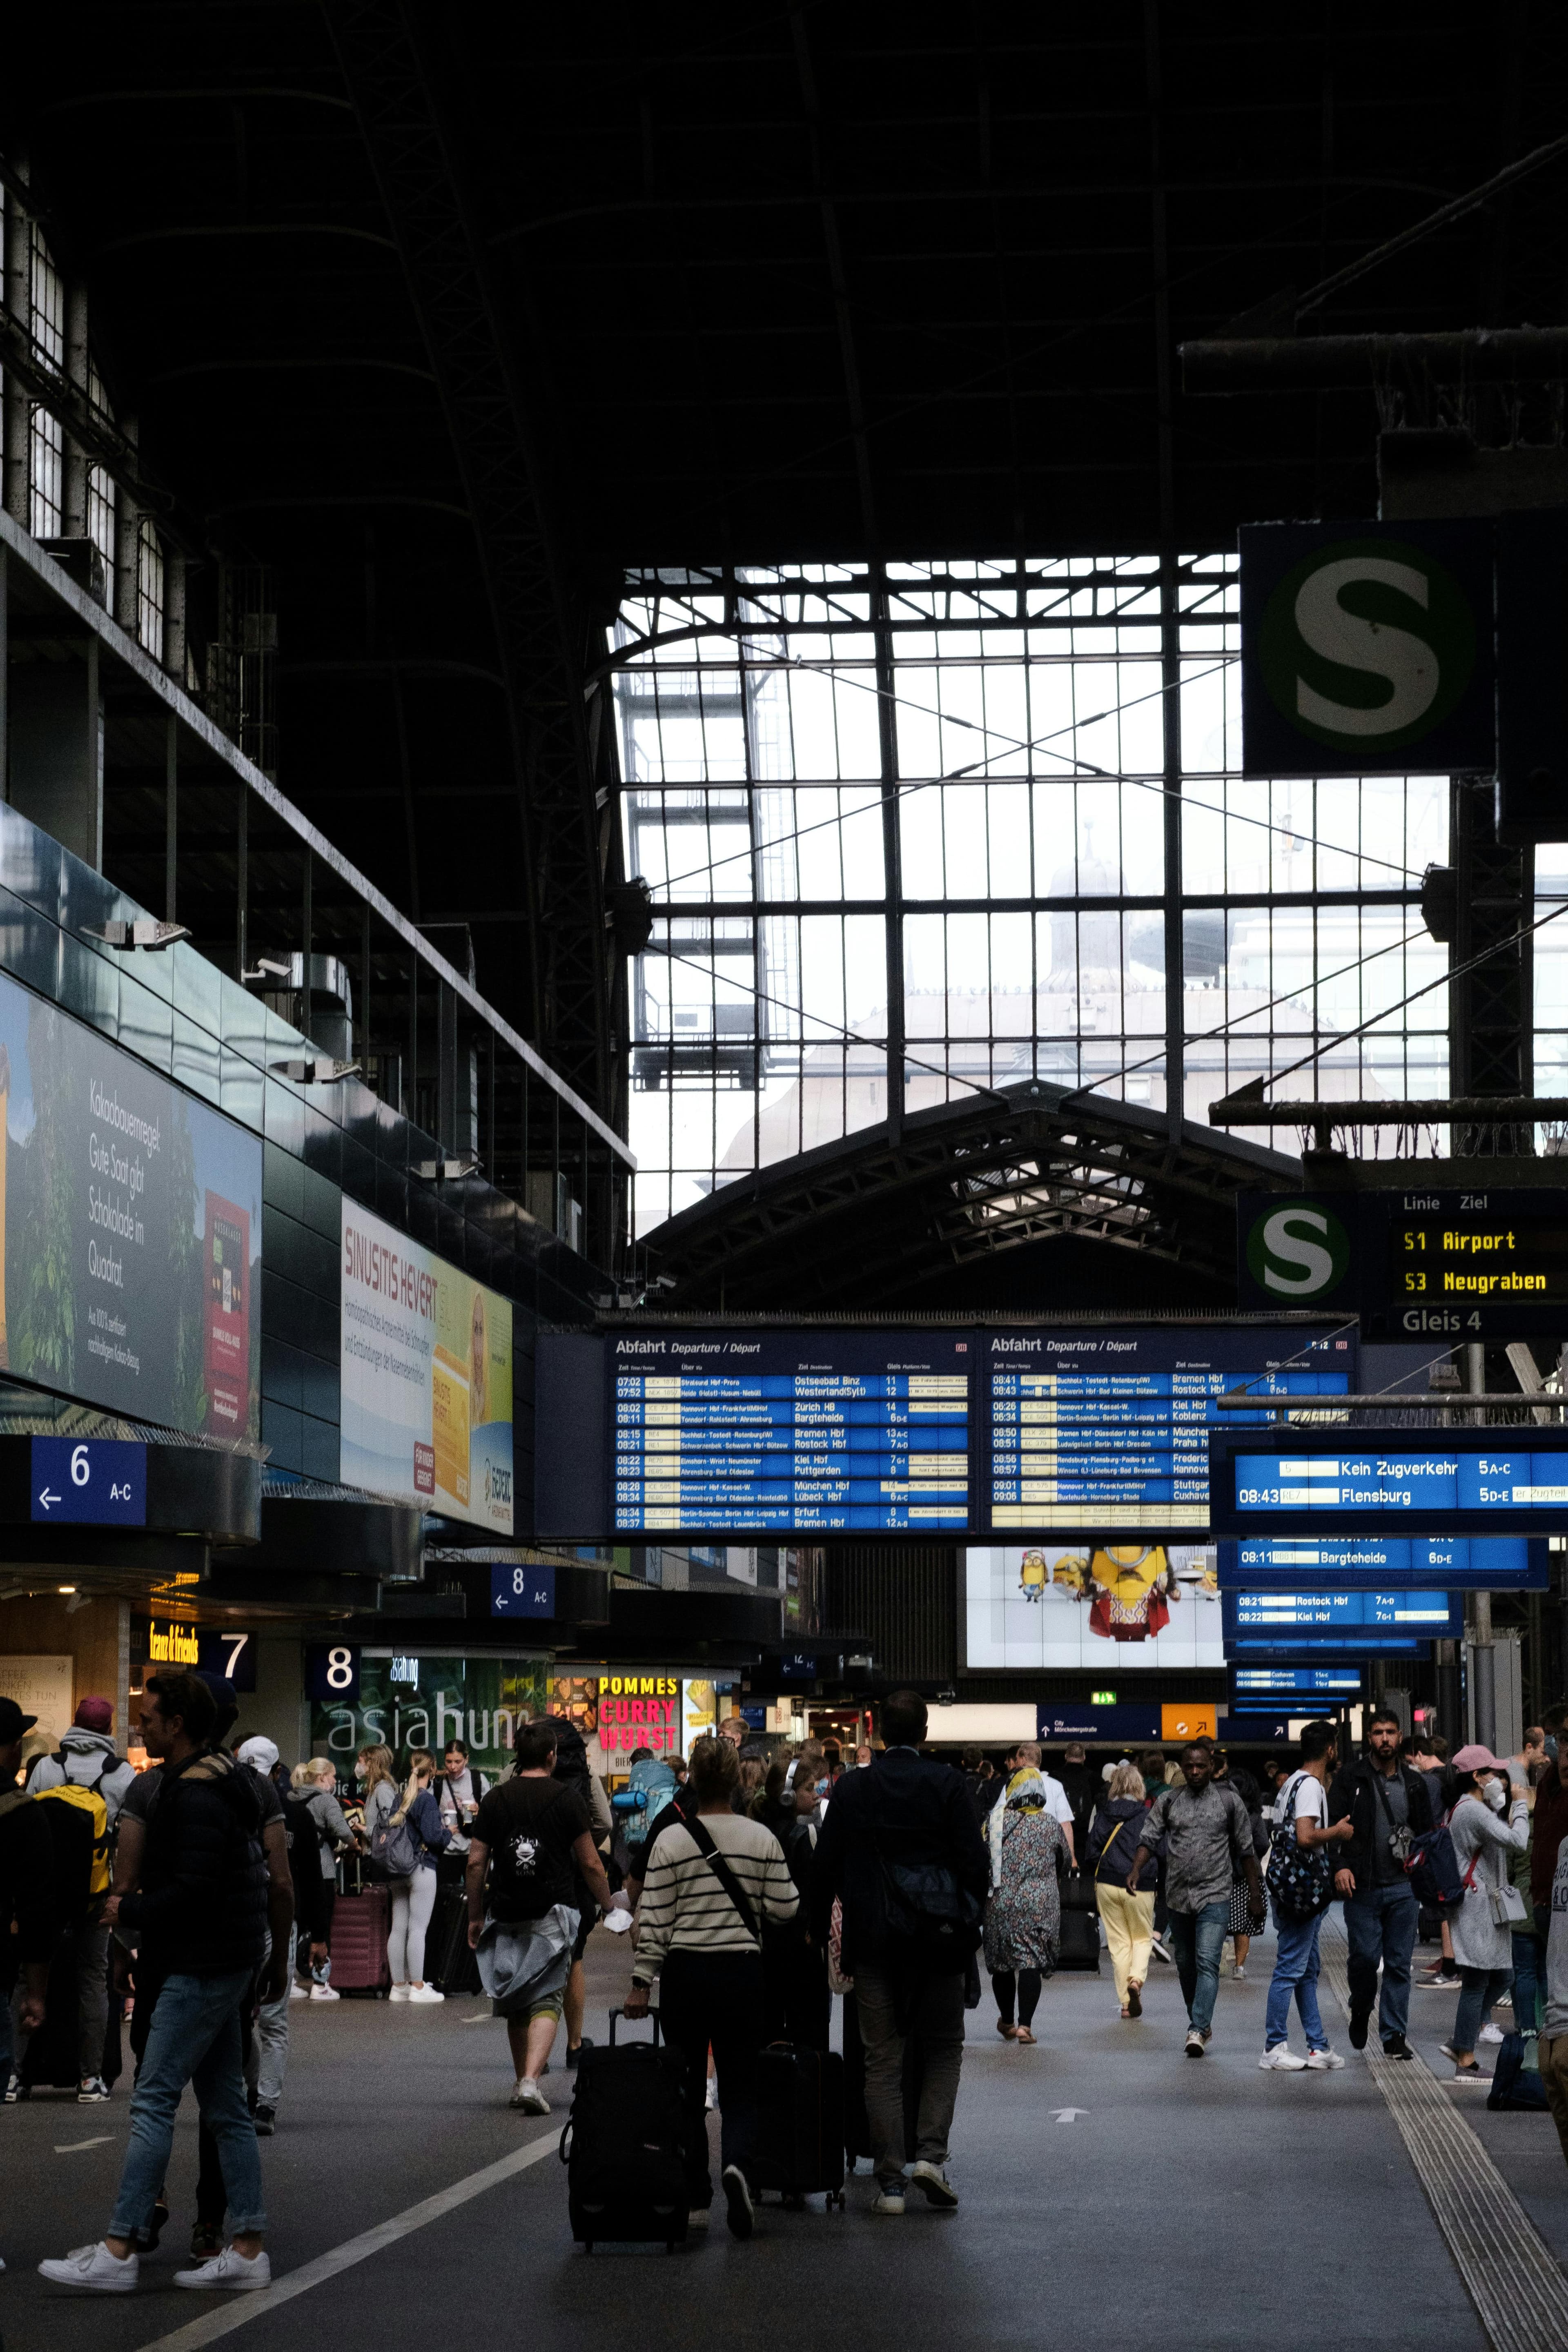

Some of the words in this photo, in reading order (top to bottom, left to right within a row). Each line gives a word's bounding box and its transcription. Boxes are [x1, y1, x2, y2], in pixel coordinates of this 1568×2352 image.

[1295, 557, 1440, 735] S
[89, 1132, 109, 1176] Gute
[111, 1144, 128, 1185] Saat
[130, 1155, 144, 1200] gibt
[1403, 1196, 1440, 1210] Linie
[1460, 1196, 1488, 1209] Ziel
[89, 1185, 134, 1241] Schokolade
[135, 1212, 144, 1245] im
[1405, 1232, 1426, 1250] S1
[1443, 1231, 1515, 1253] Airport
[1263, 1208, 1332, 1295] S
[89, 1239, 123, 1288] Quadrat.
[345, 1226, 398, 1301] SINUSITIS
[401, 1259, 438, 1323] HEVERT
[1405, 1273, 1426, 1291] S3
[1444, 1272, 1546, 1294] Neugraben
[1403, 1310, 1461, 1332] Gleis
[1467, 1312, 1482, 1331] 4
[616, 1340, 666, 1354] Abfahrt
[671, 1343, 721, 1356] Departure
[730, 1342, 761, 1354] Départ
[991, 1338, 1042, 1352] Abfahrt
[1047, 1341, 1097, 1353] Departure
[1107, 1340, 1137, 1352] Départ
[617, 1377, 640, 1386] 07:02
[795, 1376, 839, 1385] Ostseebad
[842, 1376, 860, 1385] Binz
[886, 1376, 895, 1385] 11
[993, 1375, 1016, 1384] 08:41
[1172, 1374, 1205, 1383] Bremen
[1209, 1374, 1223, 1383] Hbf
[617, 1388, 640, 1397] 07:52
[886, 1387, 896, 1396] 12
[993, 1386, 1016, 1395] 08:43
[1172, 1385, 1207, 1394] Rostock
[1210, 1385, 1225, 1394] Hbf
[617, 1403, 640, 1412] 08:02
[795, 1402, 821, 1412] Zürich
[824, 1403, 835, 1412] HB
[886, 1402, 896, 1411] 14
[1172, 1400, 1188, 1409] Kiel
[1192, 1400, 1207, 1409] Hbf
[617, 1414, 640, 1423] 08:11
[795, 1413, 844, 1424] Bargteheide
[1172, 1411, 1207, 1420] Koblenz
[1266, 1411, 1276, 1420] 14
[617, 1430, 640, 1439] 08:15
[795, 1429, 826, 1438] Bremen
[830, 1429, 844, 1438] Hbf
[993, 1428, 1016, 1437] 08:50
[617, 1440, 640, 1450] 08:21
[795, 1439, 828, 1449] Rostock
[832, 1439, 846, 1449] Hbf
[993, 1439, 1016, 1448] 08:51
[1173, 1438, 1198, 1447] Praha
[617, 1456, 640, 1465] 08:22
[795, 1455, 810, 1464] Kiel
[813, 1455, 828, 1464] Hbf
[993, 1454, 1016, 1463] 08:56
[70, 1445, 90, 1486] 6
[110, 1483, 131, 1501] A-C
[617, 1466, 640, 1476] 08:23
[795, 1466, 841, 1477] Puttgarden
[890, 1466, 896, 1475] 8
[993, 1465, 1016, 1474] 08:57
[1341, 1461, 1370, 1475] Kein
[1376, 1461, 1458, 1479] Zugverkehr
[795, 1481, 832, 1490] München
[835, 1481, 850, 1490] Hbf
[887, 1481, 895, 1489] 14
[993, 1481, 1016, 1490] 09:01
[617, 1493, 640, 1502] 08:34
[794, 1492, 824, 1501] Lübeck
[828, 1492, 842, 1501] Hbf
[993, 1492, 1016, 1501] 09:06
[1239, 1489, 1279, 1503] 08:43
[1283, 1490, 1301, 1500] RE7
[1342, 1488, 1411, 1506] Flensburg
[617, 1508, 640, 1517] 08:34
[794, 1507, 820, 1517] Erfurt
[890, 1507, 896, 1516] 8
[617, 1519, 640, 1528] 08:37
[794, 1518, 826, 1528] Bremen
[830, 1518, 845, 1528] Hbf
[1241, 1551, 1272, 1564] 08:11
[1321, 1552, 1386, 1566] Bargteheide
[513, 1568, 524, 1594] 8
[534, 1592, 547, 1603] A-C
[1239, 1597, 1262, 1606] 08:21
[1297, 1596, 1331, 1606] Rostock
[1334, 1596, 1348, 1606] Hbf
[1238, 1612, 1262, 1621] 08:22
[1297, 1612, 1312, 1621] Kiel
[1316, 1612, 1330, 1621] Hbf
[150, 1621, 169, 1662] franz
[175, 1625, 198, 1665] friends
[221, 1634, 248, 1678] 7
[327, 1647, 353, 1688] 8
[390, 1655, 418, 1691] asiahung
[599, 1677, 677, 1695] POMMES
[600, 1699, 675, 1724] CURRY
[599, 1726, 676, 1751] WURST
